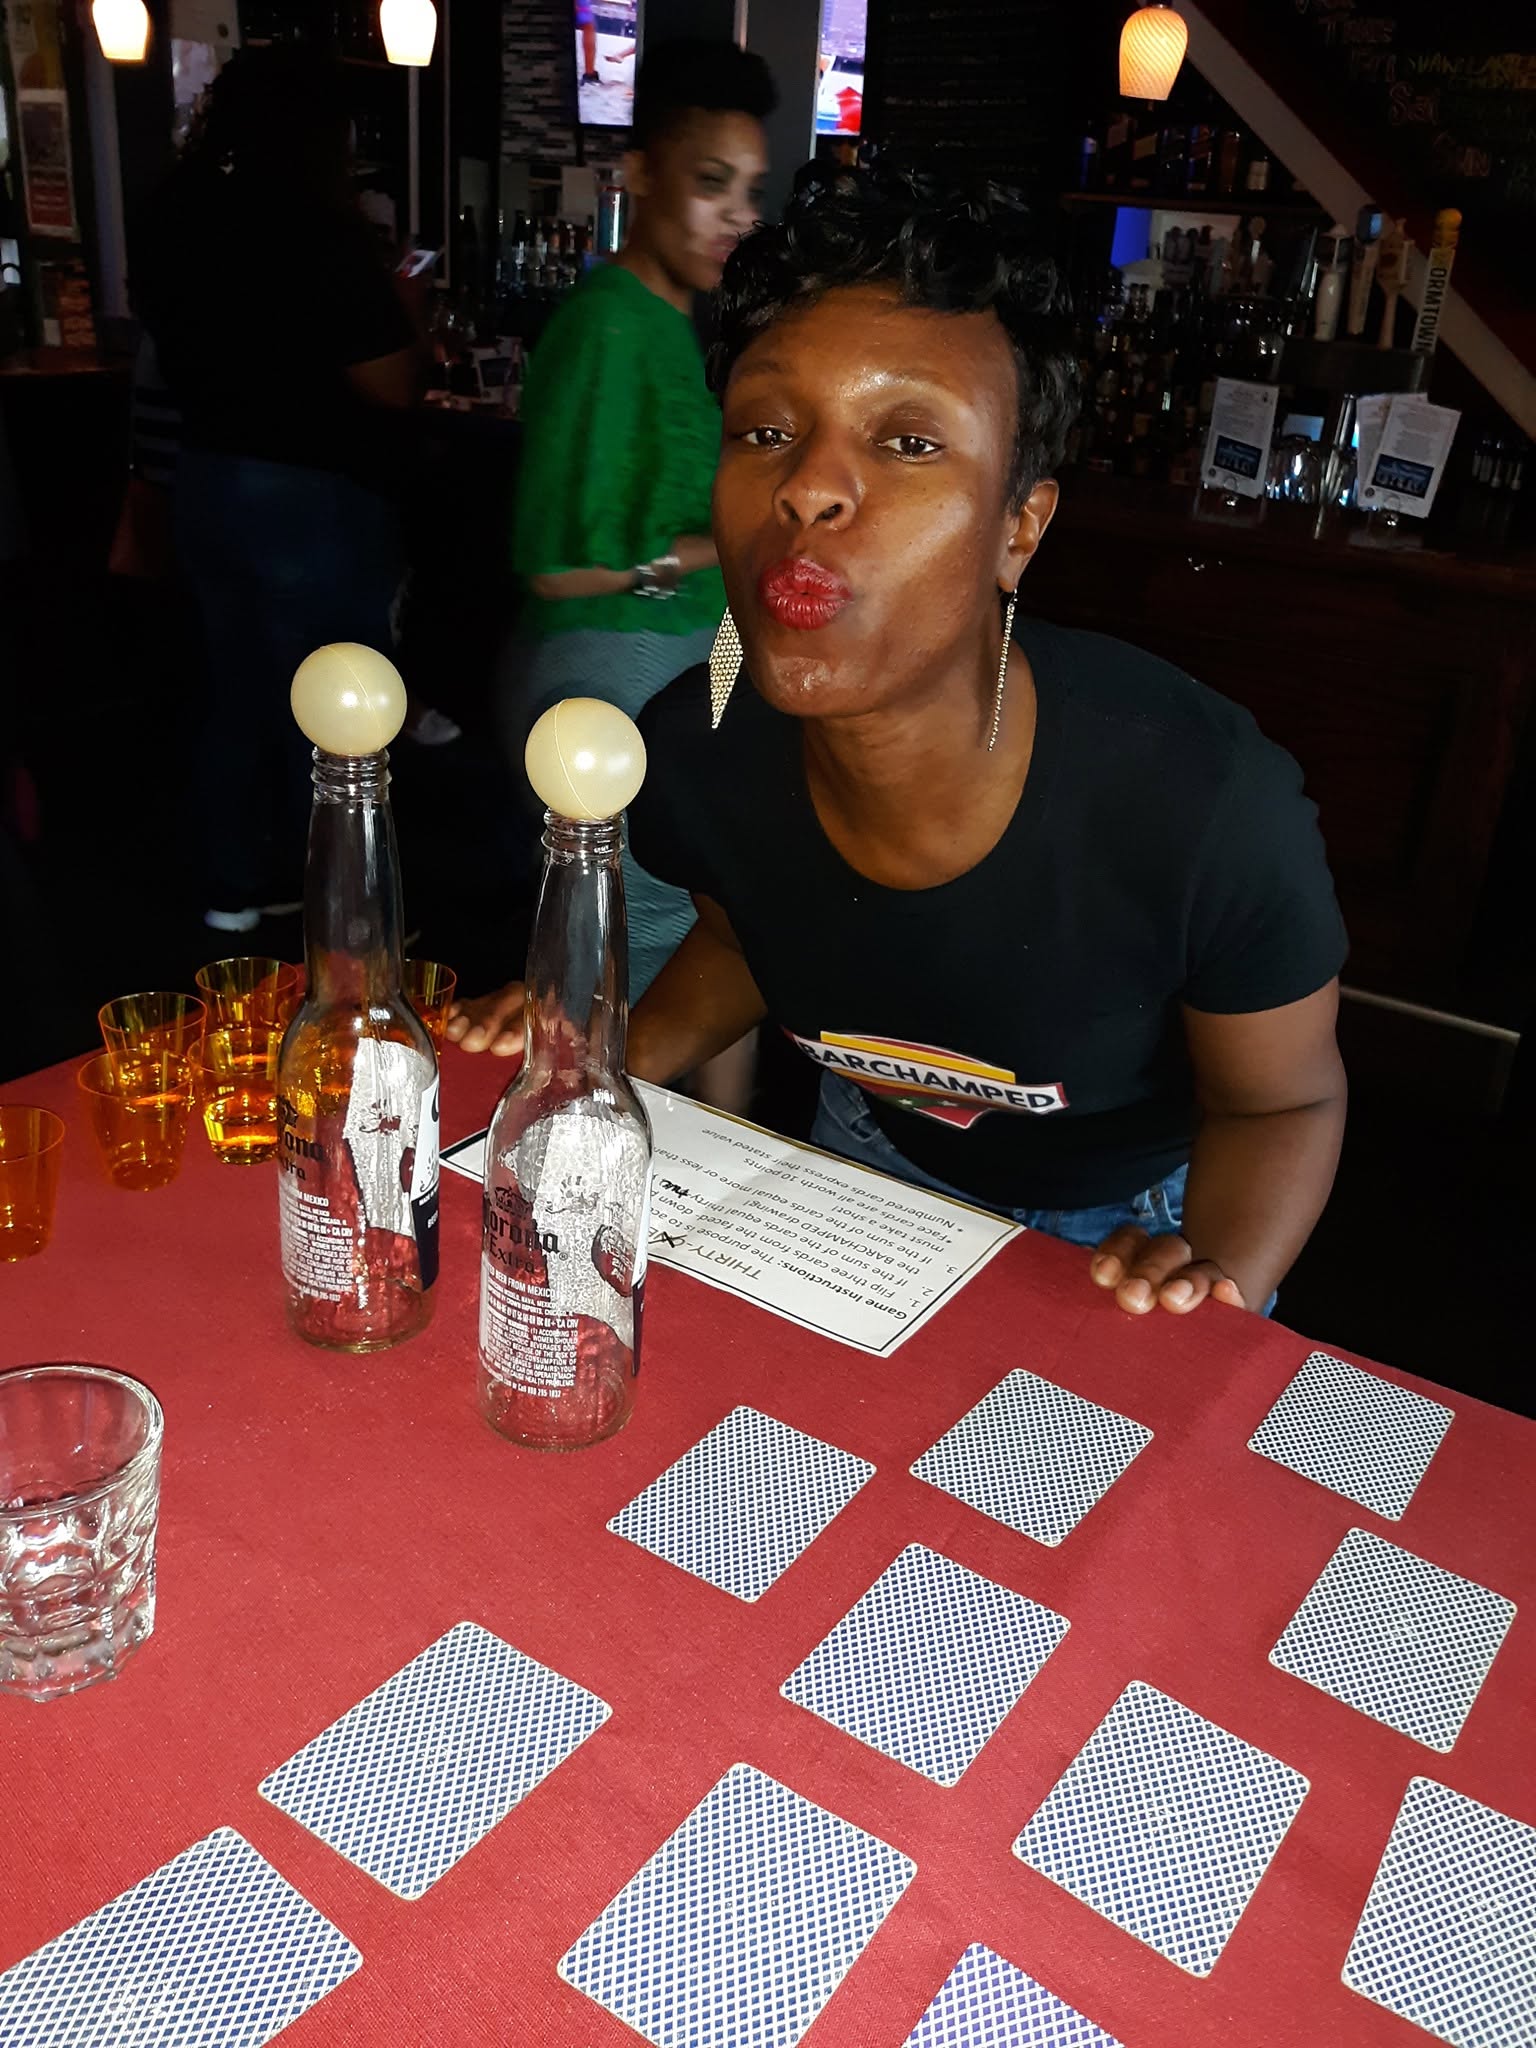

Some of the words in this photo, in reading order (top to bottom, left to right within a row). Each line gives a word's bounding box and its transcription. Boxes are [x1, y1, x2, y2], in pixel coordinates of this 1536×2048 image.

[798, 1043, 1056, 1109] BARCHAMPED
[701, 1127, 733, 1144] value
[653, 1146, 677, 1162] than
[732, 1141, 774, 1160] stated
[679, 1158, 701, 1173] less
[743, 1157, 781, 1177] points
[772, 1157, 802, 1172] their
[704, 1168, 719, 1178] or
[780, 1173, 799, 1183] 10
[802, 1166, 850, 1190] express
[720, 1176, 753, 1193] more
[800, 1178, 838, 1198] worth
[303, 1192, 329, 1208] MEXICO
[751, 1188, 789, 1205] equal
[839, 1193, 856, 1205] all
[850, 1186, 885, 1203] cards
[659, 1195, 694, 1215] down
[742, 1200, 800, 1226] drawing!
[789, 1200, 824, 1220] cards
[831, 1204, 867, 1222] shot!
[856, 1201, 879, 1213] are
[695, 1213, 734, 1230] faced-
[725, 1207, 763, 1224] equal
[881, 1210, 915, 1228] cards
[884, 1199, 956, 1229] Numbered
[484, 1208, 560, 1254] orona
[668, 1217, 682, 1229] to
[684, 1223, 696, 1232] is
[764, 1221, 798, 1240] cards
[825, 1216, 847, 1230] the
[847, 1225, 865, 1236] of
[697, 1229, 751, 1250] purpose
[735, 1225, 758, 1238] the
[879, 1223, 909, 1241] take
[345, 1237, 354, 1245] TO
[759, 1235, 792, 1254] from
[799, 1236, 820, 1250] the
[800, 1221, 895, 1265] BARCHAMPED
[866, 1232, 896, 1249] sum
[910, 1236, 945, 1254] must
[490, 1233, 534, 1274] Extra
[751, 1248, 772, 1265] The
[823, 1245, 839, 1256] of
[896, 1244, 920, 1260] the
[793, 1249, 829, 1269] cards
[841, 1253, 871, 1271] sum
[919, 1254, 933, 1266] If
[831, 1265, 868, 1288] three
[873, 1268, 896, 1281] the
[896, 1262, 920, 1277] the
[945, 1264, 958, 1275] 3.
[495, 1269, 508, 1286] BEER
[508, 1276, 526, 1292] FROM
[527, 1284, 556, 1299] MEXICO
[777, 1258, 863, 1303] Instructions:
[894, 1275, 909, 1288] If
[870, 1283, 896, 1299] Flip
[920, 1285, 934, 1297] 2.
[536, 1300, 556, 1309] MEXICO
[865, 1297, 907, 1320] Game
[909, 1297, 921, 1308] 1.
[567, 1319, 579, 1329] CRV
[533, 1334, 554, 1344] WOMEN
[554, 1336, 579, 1346] SHOULD
[539, 1329, 570, 1338] ACCORDING
[571, 1330, 579, 1338] TO
[529, 1341, 562, 1352] BEVERAGES
[534, 1349, 542, 1357] OF
[543, 1350, 554, 1359] THE
[554, 1352, 569, 1360] RISK
[569, 1352, 577, 1360] OF
[524, 1354, 568, 1367] CONSUMPTION
[568, 1358, 577, 1367] OF
[533, 1362, 560, 1373] IMPAIRS
[560, 1365, 577, 1374] YOUR
[525, 1374, 545, 1386] HEALTH
